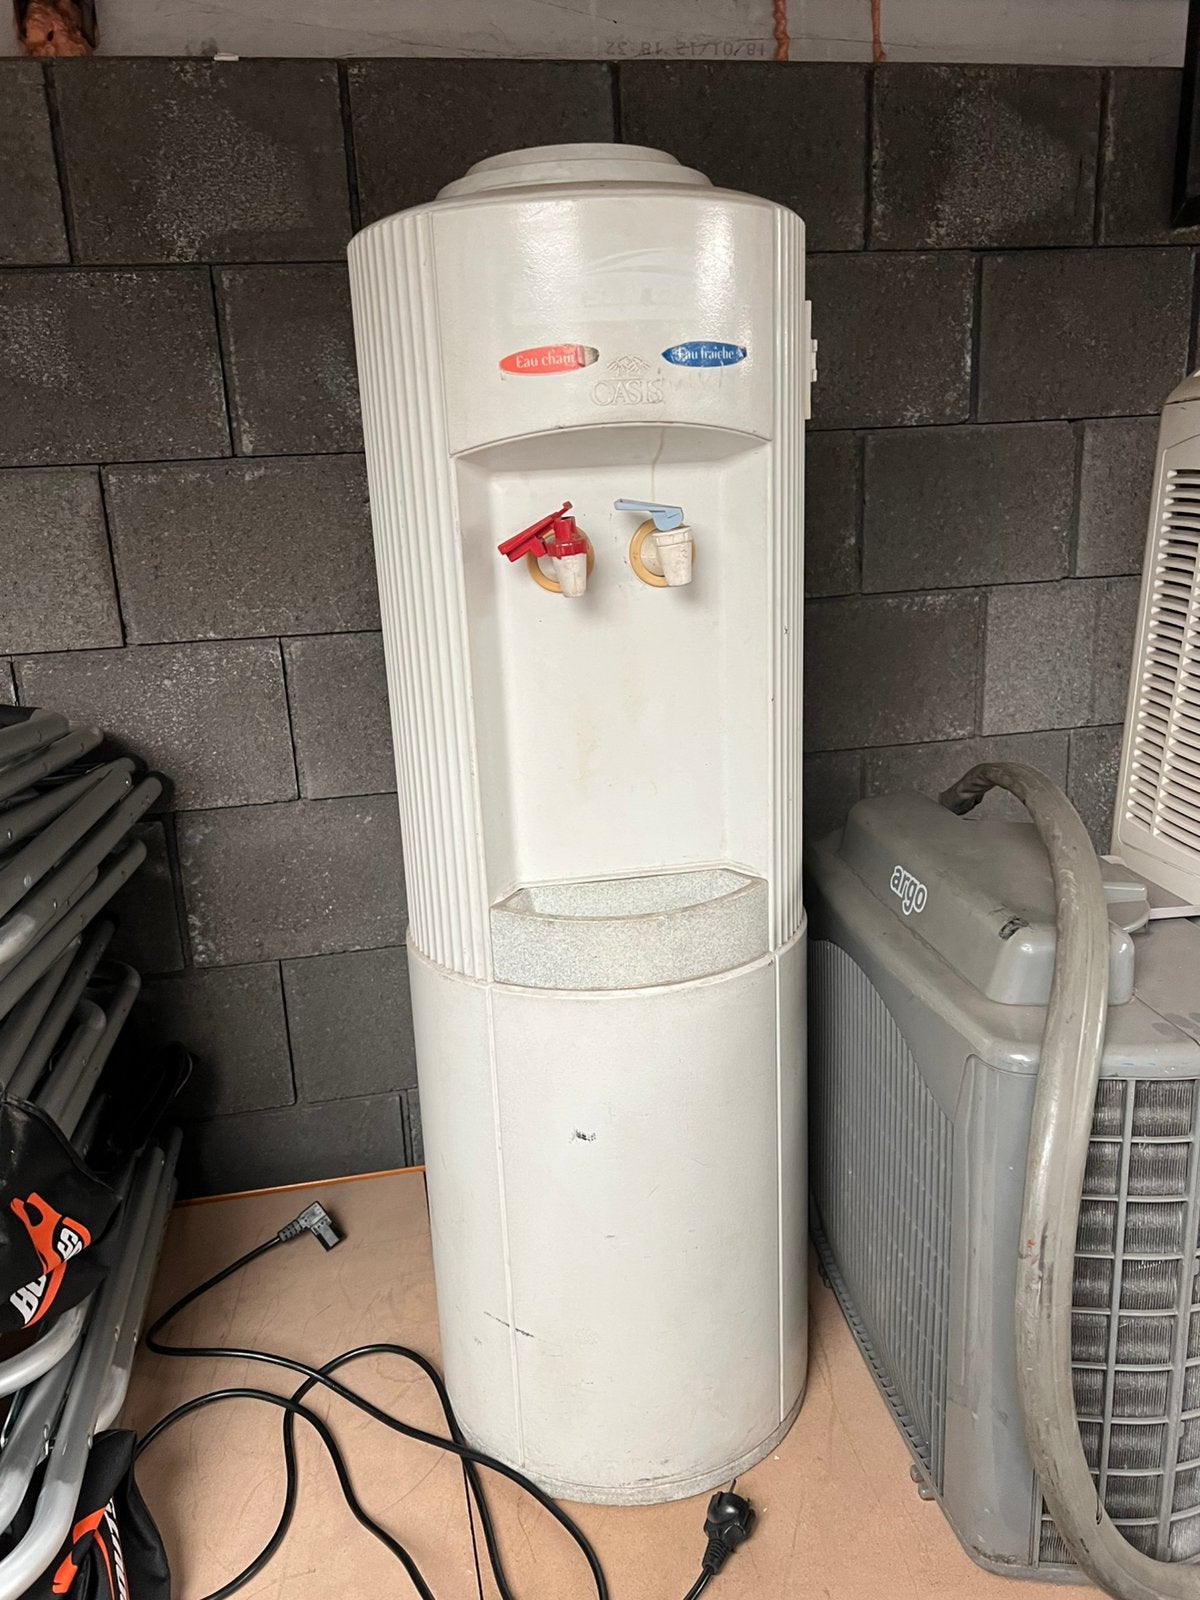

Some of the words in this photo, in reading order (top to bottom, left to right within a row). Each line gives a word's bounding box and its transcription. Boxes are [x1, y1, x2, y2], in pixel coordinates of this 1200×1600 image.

[515, 355, 539, 369] Eau
[592, 379, 665, 406] OASIS
[890, 865, 928, 915] argo
